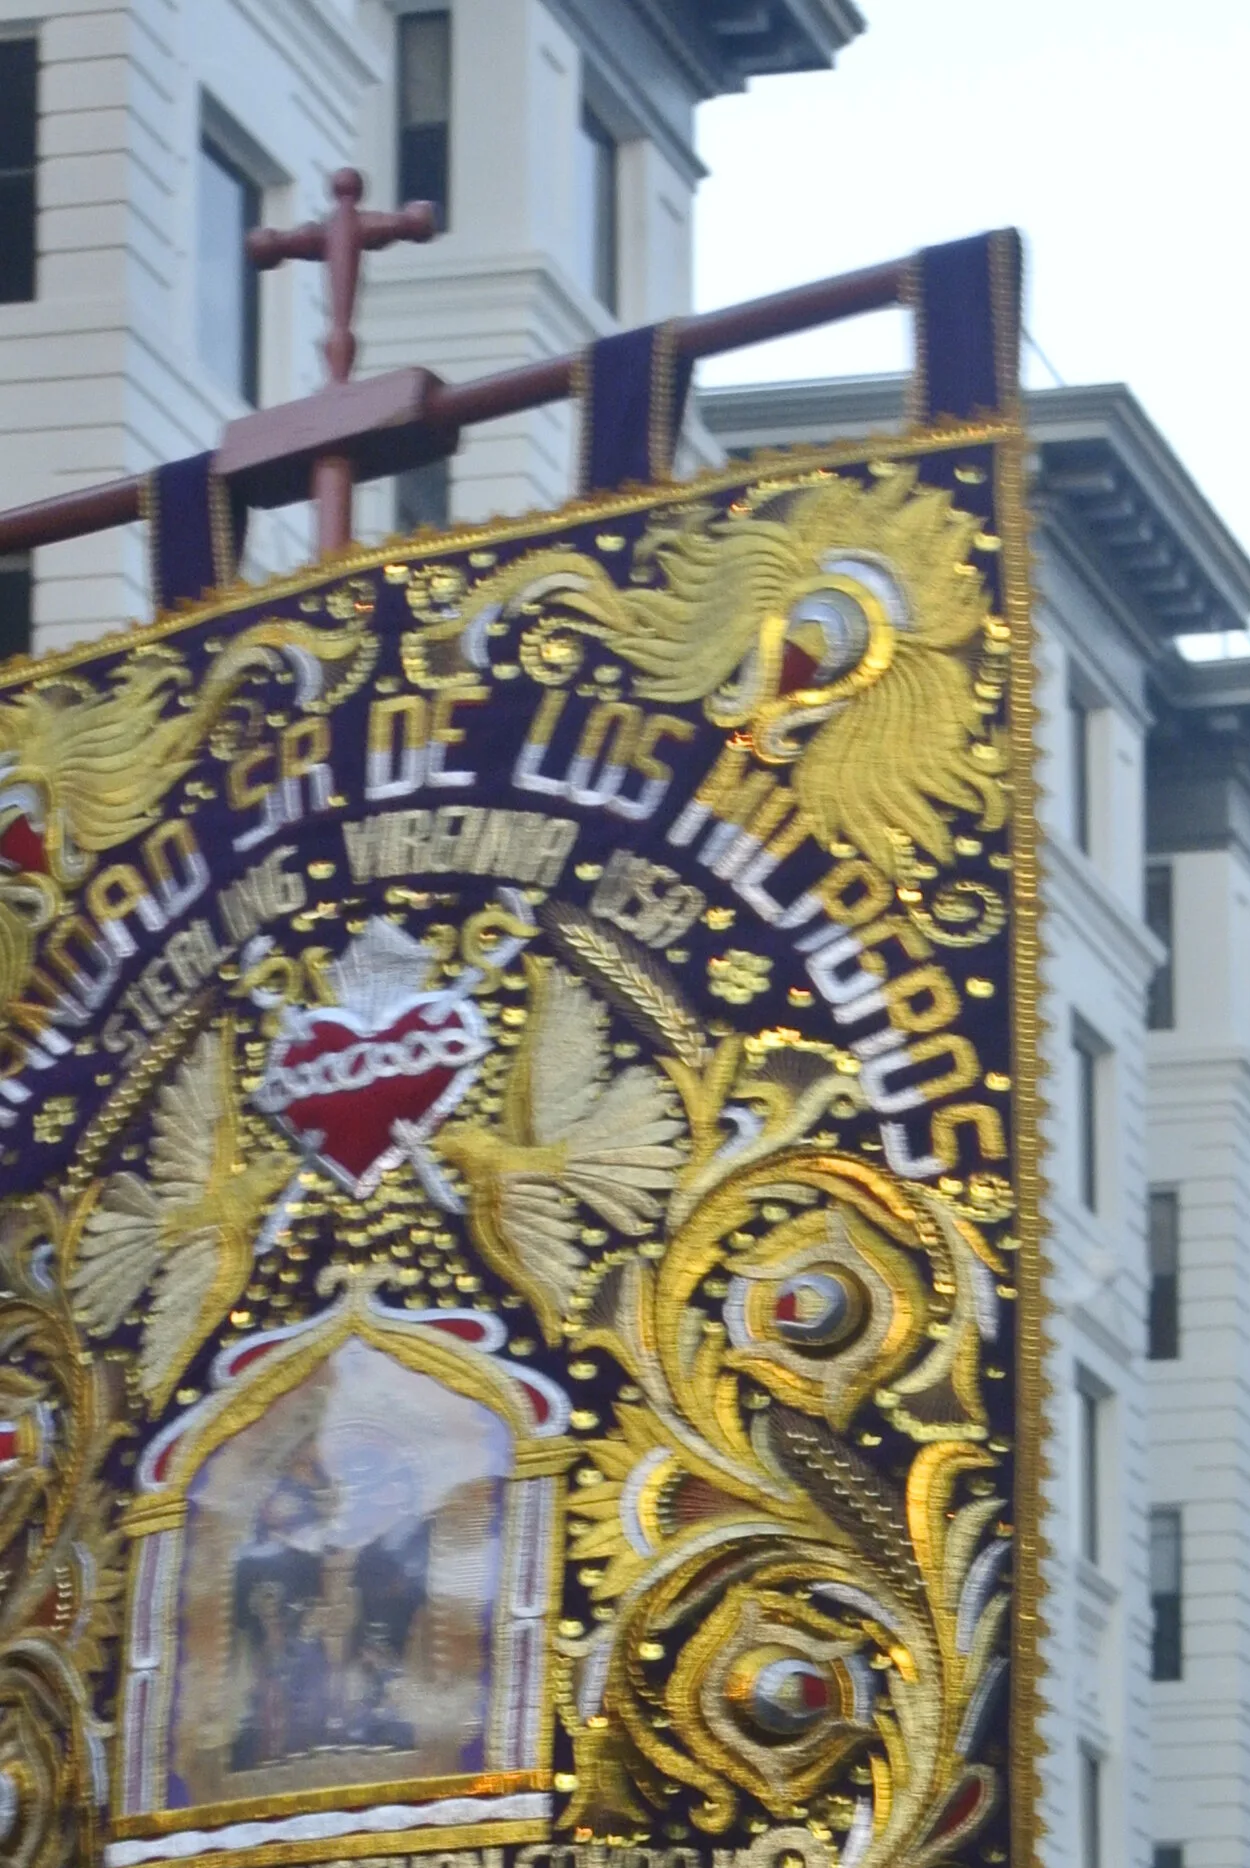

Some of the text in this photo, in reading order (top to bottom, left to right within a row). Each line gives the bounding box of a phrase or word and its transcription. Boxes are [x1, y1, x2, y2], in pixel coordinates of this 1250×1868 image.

[103, 805, 708, 1068] STERLING VIRGINIA USA
[364, 685, 493, 801] DE
[511, 688, 697, 821] LOS
[667, 745, 1008, 1179] MILAGROS
